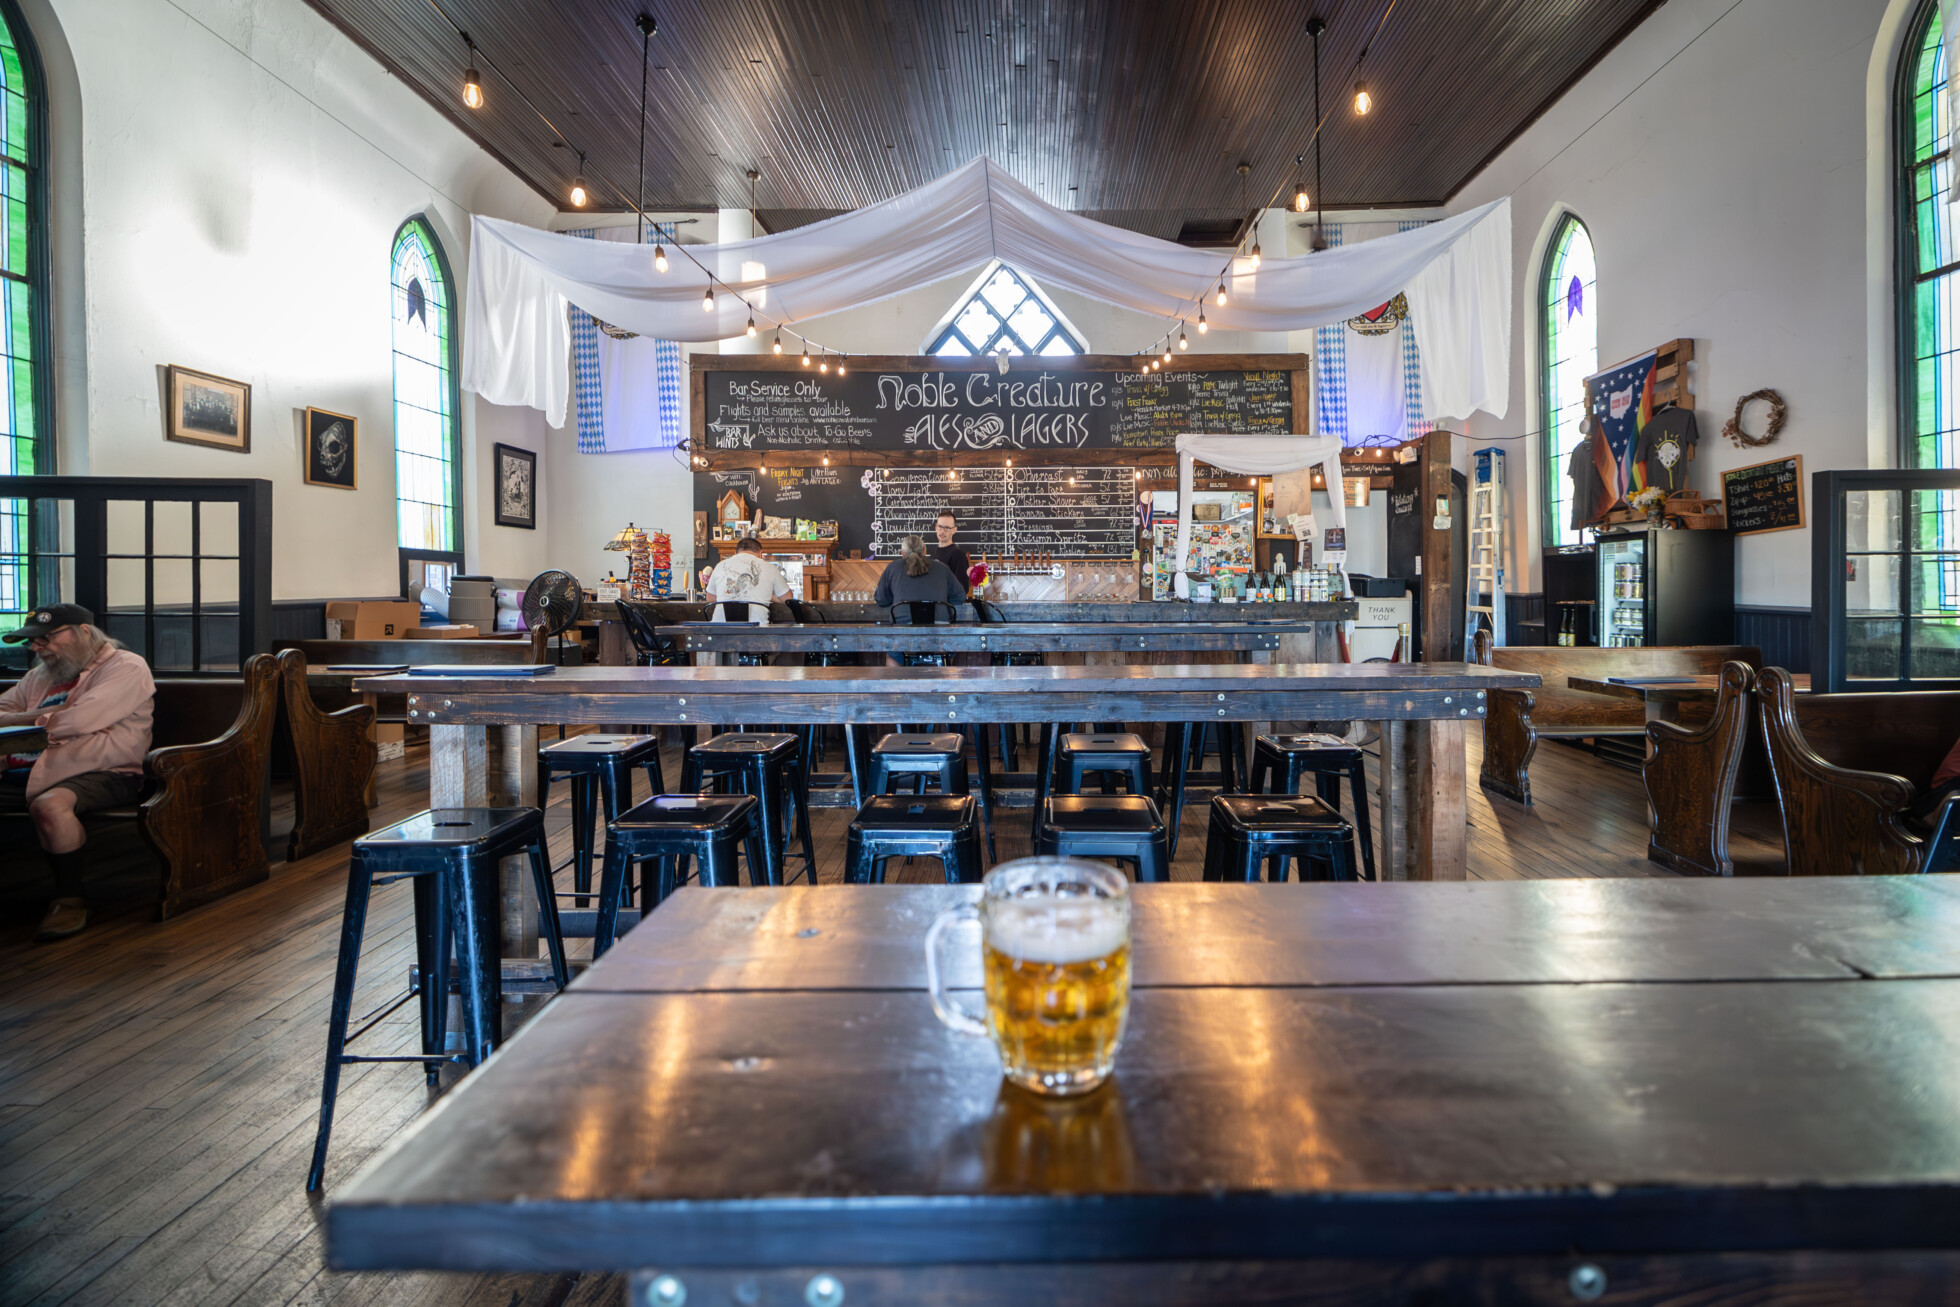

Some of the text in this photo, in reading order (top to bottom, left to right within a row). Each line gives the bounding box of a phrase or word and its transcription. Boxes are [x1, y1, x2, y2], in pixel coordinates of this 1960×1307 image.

[1115, 372, 1162, 389] Upcoming
[729, 379, 822, 400] Bar Service Only
[876, 371, 1106, 411] Noble Creature
[719, 399, 851, 420] Flights and samples available
[762, 415, 775, 423] beer
[725, 428, 742, 438] BAR
[757, 424, 776, 437] Ask
[778, 427, 789, 437] us
[791, 424, 818, 437] about
[823, 424, 846, 437] To-Go
[914, 413, 963, 451] ALES
[974, 421, 1000, 445] AND
[1011, 413, 1090, 450] LAGERS
[715, 436, 740, 449] HINTS
[884, 468, 966, 484] Conversationast
[1006, 468, 1015, 482] 8
[1007, 482, 1014, 494] 9
[1006, 495, 1016, 507] 10
[1006, 507, 1016, 518] 11
[1007, 519, 1017, 531] 12
[1007, 531, 1017, 543] 13
[1017, 532, 1053, 543] Autumn
[1054, 530, 1088, 544] Spritz
[1368, 606, 1396, 614] THANK
[1372, 614, 1390, 622] YOU
